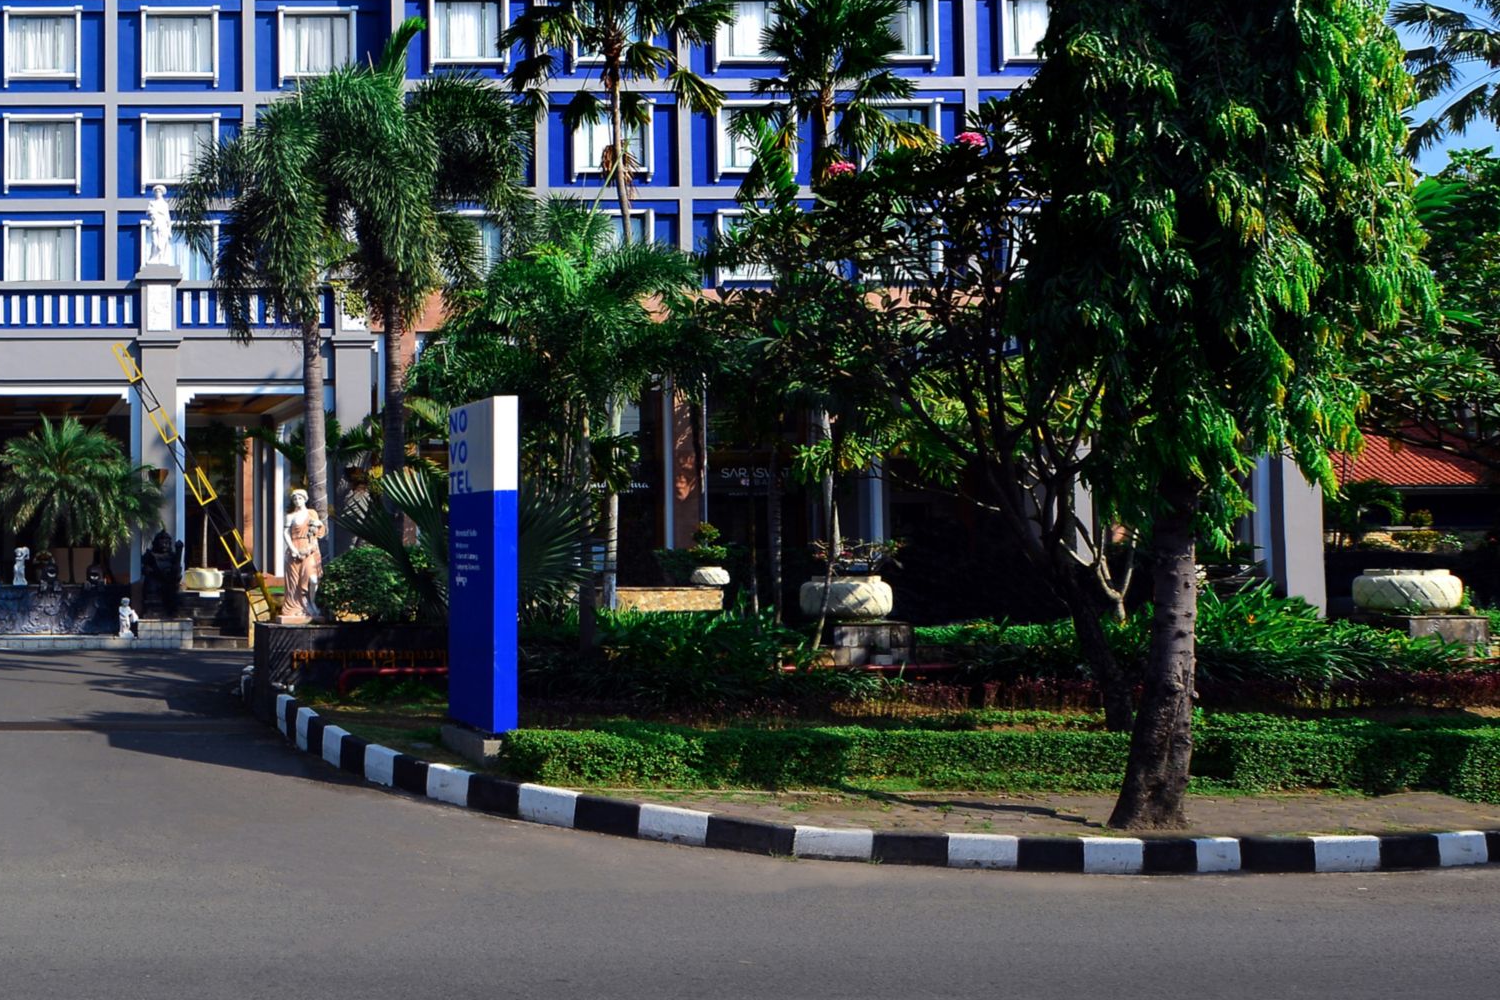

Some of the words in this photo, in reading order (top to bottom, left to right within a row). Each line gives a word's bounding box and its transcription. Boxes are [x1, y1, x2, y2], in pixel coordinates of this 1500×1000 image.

[450, 409, 468, 434] NO
[450, 441, 468, 465] VO
[449, 470, 472, 494] TEL
